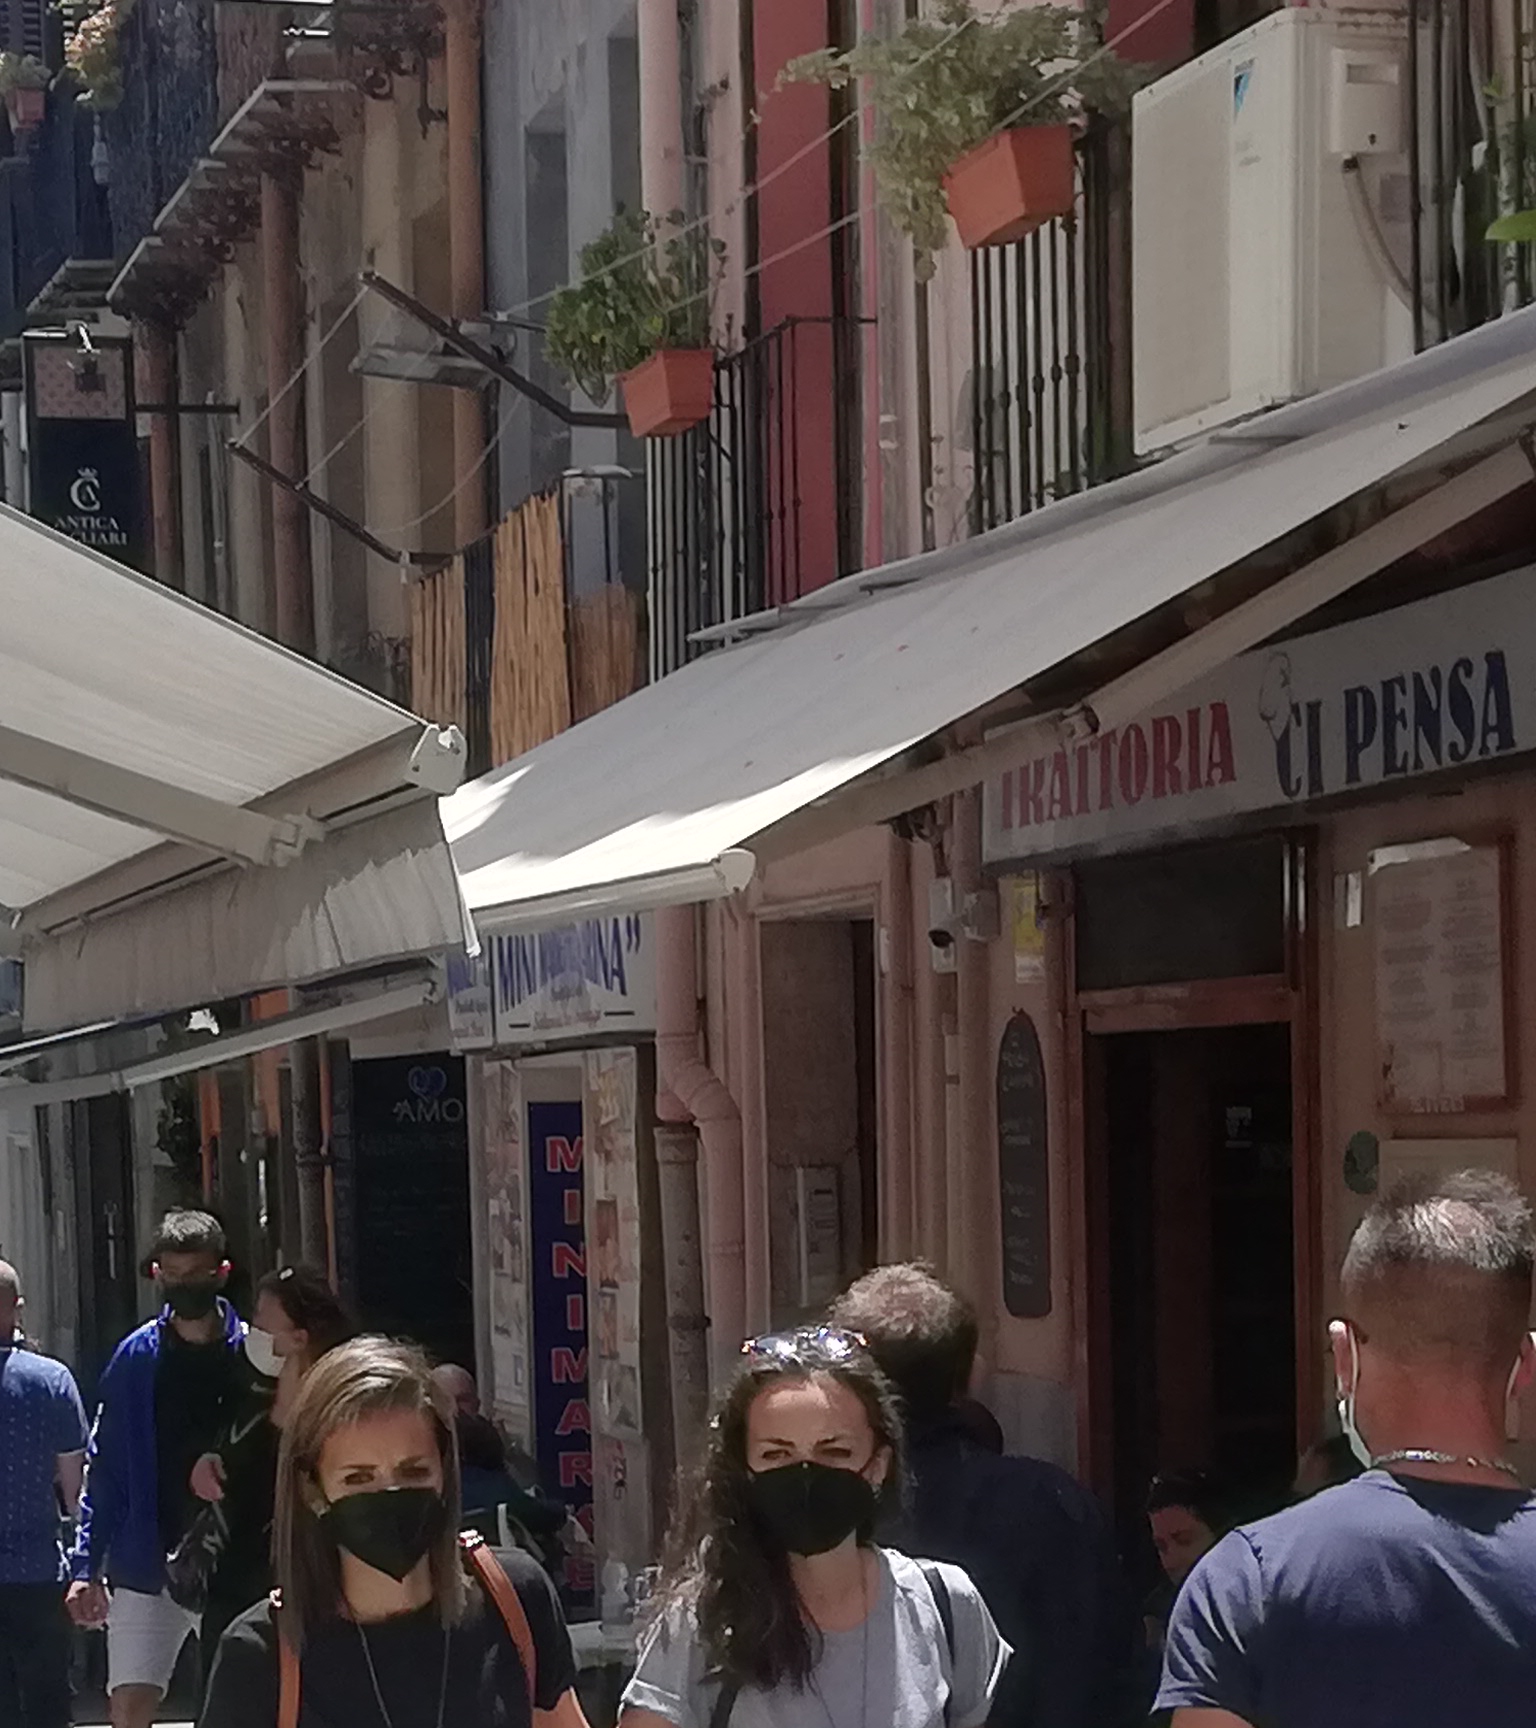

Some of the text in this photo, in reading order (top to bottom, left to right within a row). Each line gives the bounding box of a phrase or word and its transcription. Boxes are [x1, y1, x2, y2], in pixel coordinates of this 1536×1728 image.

[54, 514, 119, 531] ANTICA
[1001, 701, 1238, 830] TRATTORIA
[1274, 699, 1326, 799] CI
[1343, 650, 1517, 785] PENSA
